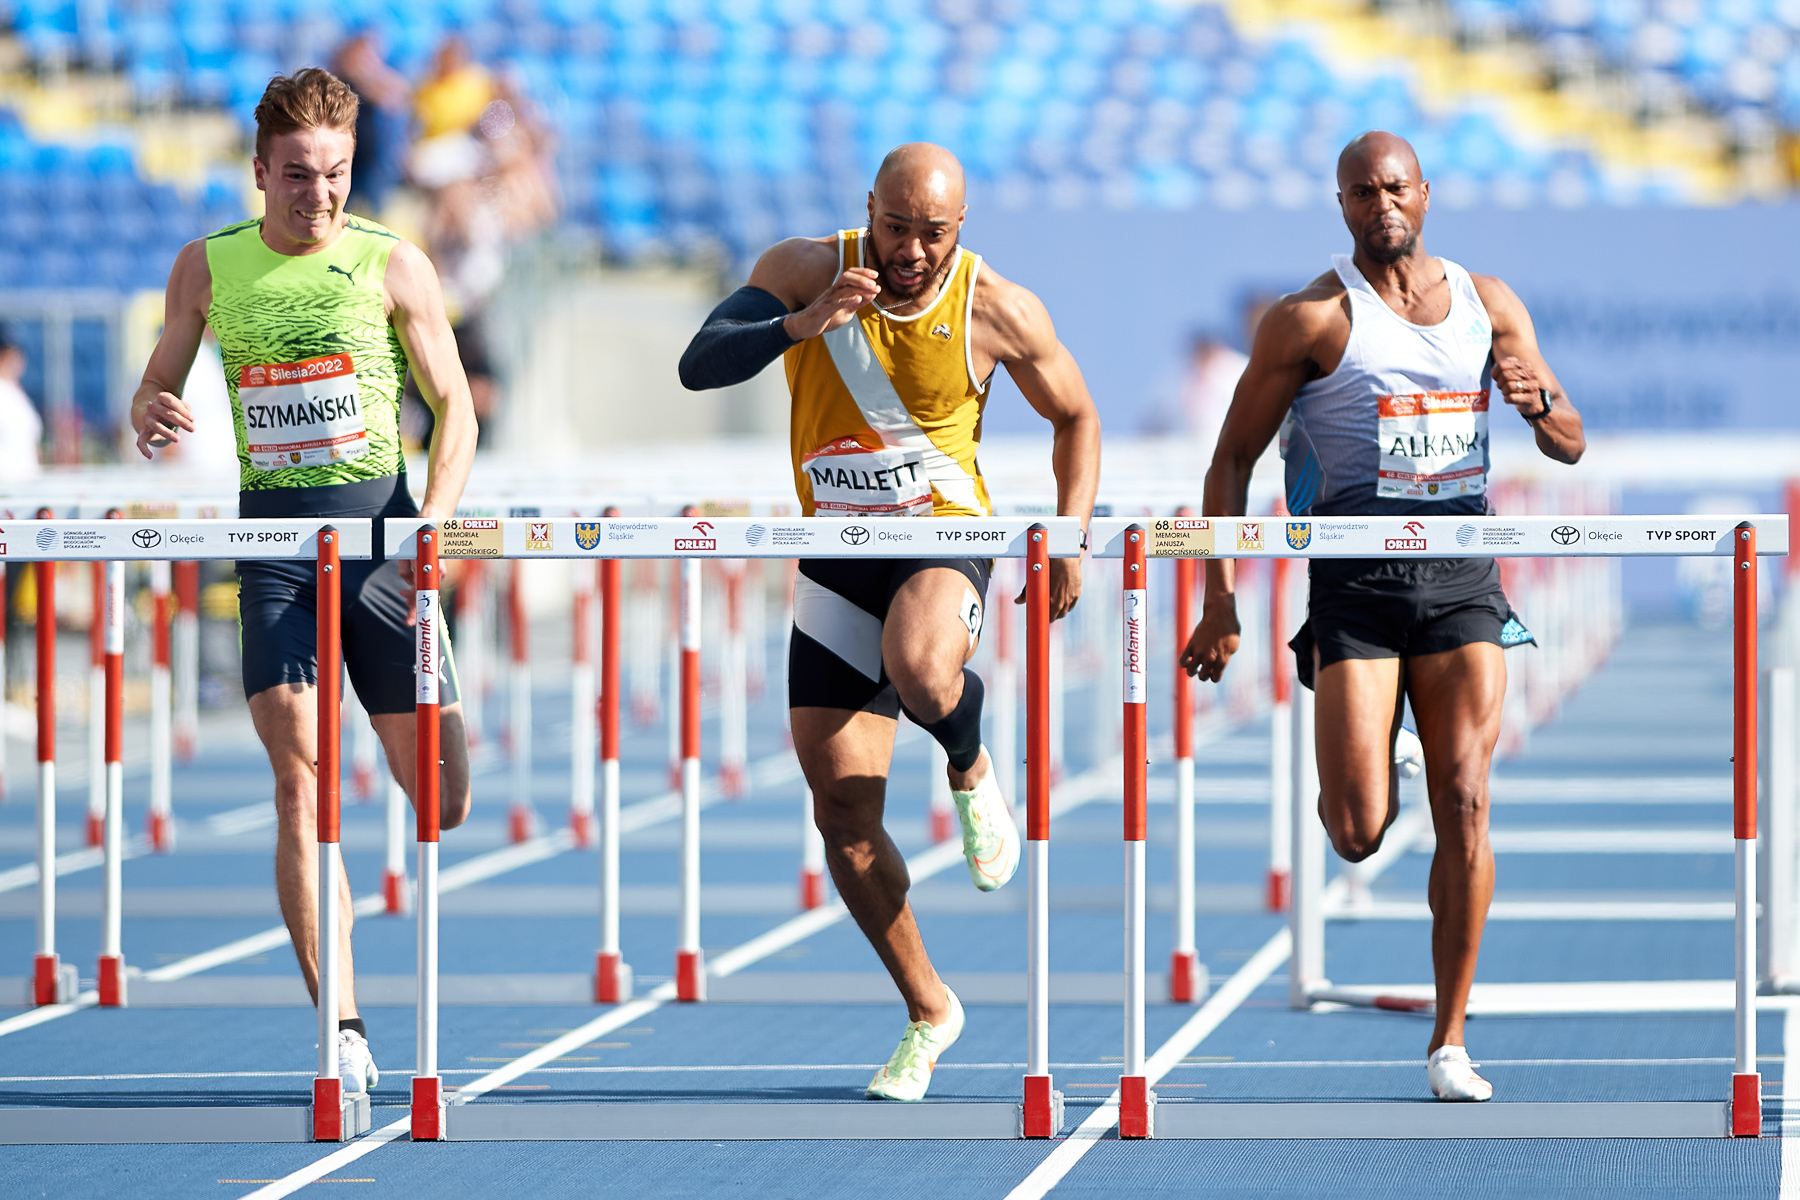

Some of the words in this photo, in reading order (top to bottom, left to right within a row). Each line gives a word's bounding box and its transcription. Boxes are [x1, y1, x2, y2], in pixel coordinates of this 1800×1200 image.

[270, 359, 342, 380] Silesia2022
[248, 394, 356, 428] SZYMAŃSKI
[811, 461, 919, 491] MALLETT
[443, 520, 461, 530] 68.
[464, 520, 497, 529] ORLEN
[608, 522, 658, 531] Województwo
[1155, 520, 1173, 530] 68.
[1175, 521, 1208, 529] ORLEN
[1319, 522, 1369, 531] Województwo
[169, 534, 205, 545] Okęcie
[228, 532, 254, 543] TVP
[257, 532, 299, 542] SPORT
[608, 532, 634, 541] Śląskie
[878, 531, 913, 542] Okęcie
[936, 531, 962, 541] TVP
[965, 531, 1006, 541] SPORT
[1319, 532, 1345, 541] Śląskie
[1588, 531, 1623, 542] Okęcie
[1646, 530, 1672, 541] TVP
[1675, 530, 1717, 541] SPORT
[527, 541, 552, 549] PZLA
[676, 540, 714, 549] ORLEN
[1386, 540, 1425, 549] ORLEN
[444, 547, 498, 555] KUSOCIŃSKIEGO
[1155, 548, 1210, 556] KUSOCIŃSKIEGO
[969, 602, 981, 635] 6
[419, 617, 433, 675] polanik
[1127, 616, 1141, 673] polanik
